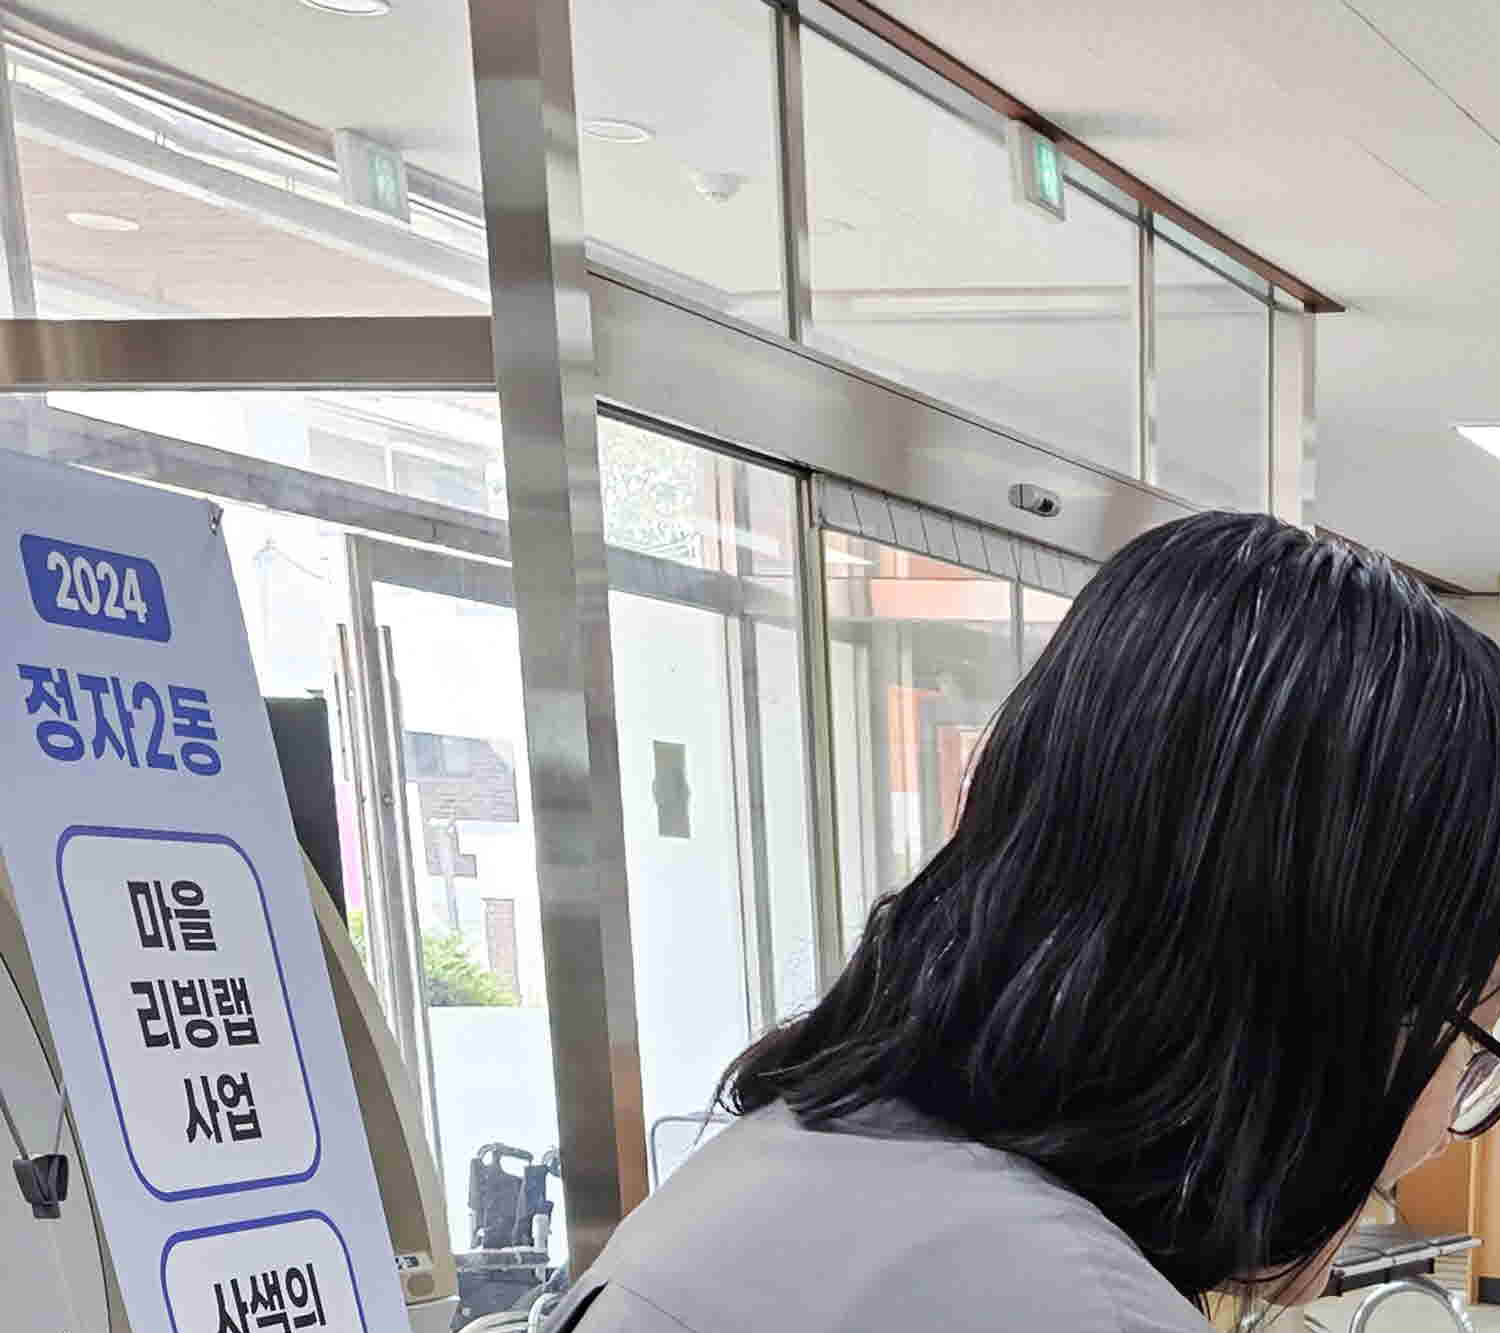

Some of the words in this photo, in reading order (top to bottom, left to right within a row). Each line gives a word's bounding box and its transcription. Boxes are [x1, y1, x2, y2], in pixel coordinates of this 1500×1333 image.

[47, 551, 149, 624] 2024
[16, 663, 223, 777] 정자2동
[126, 879, 218, 952] 마을
[130, 977, 261, 1050] 리빙랩
[183, 1072, 262, 1144] 사업
